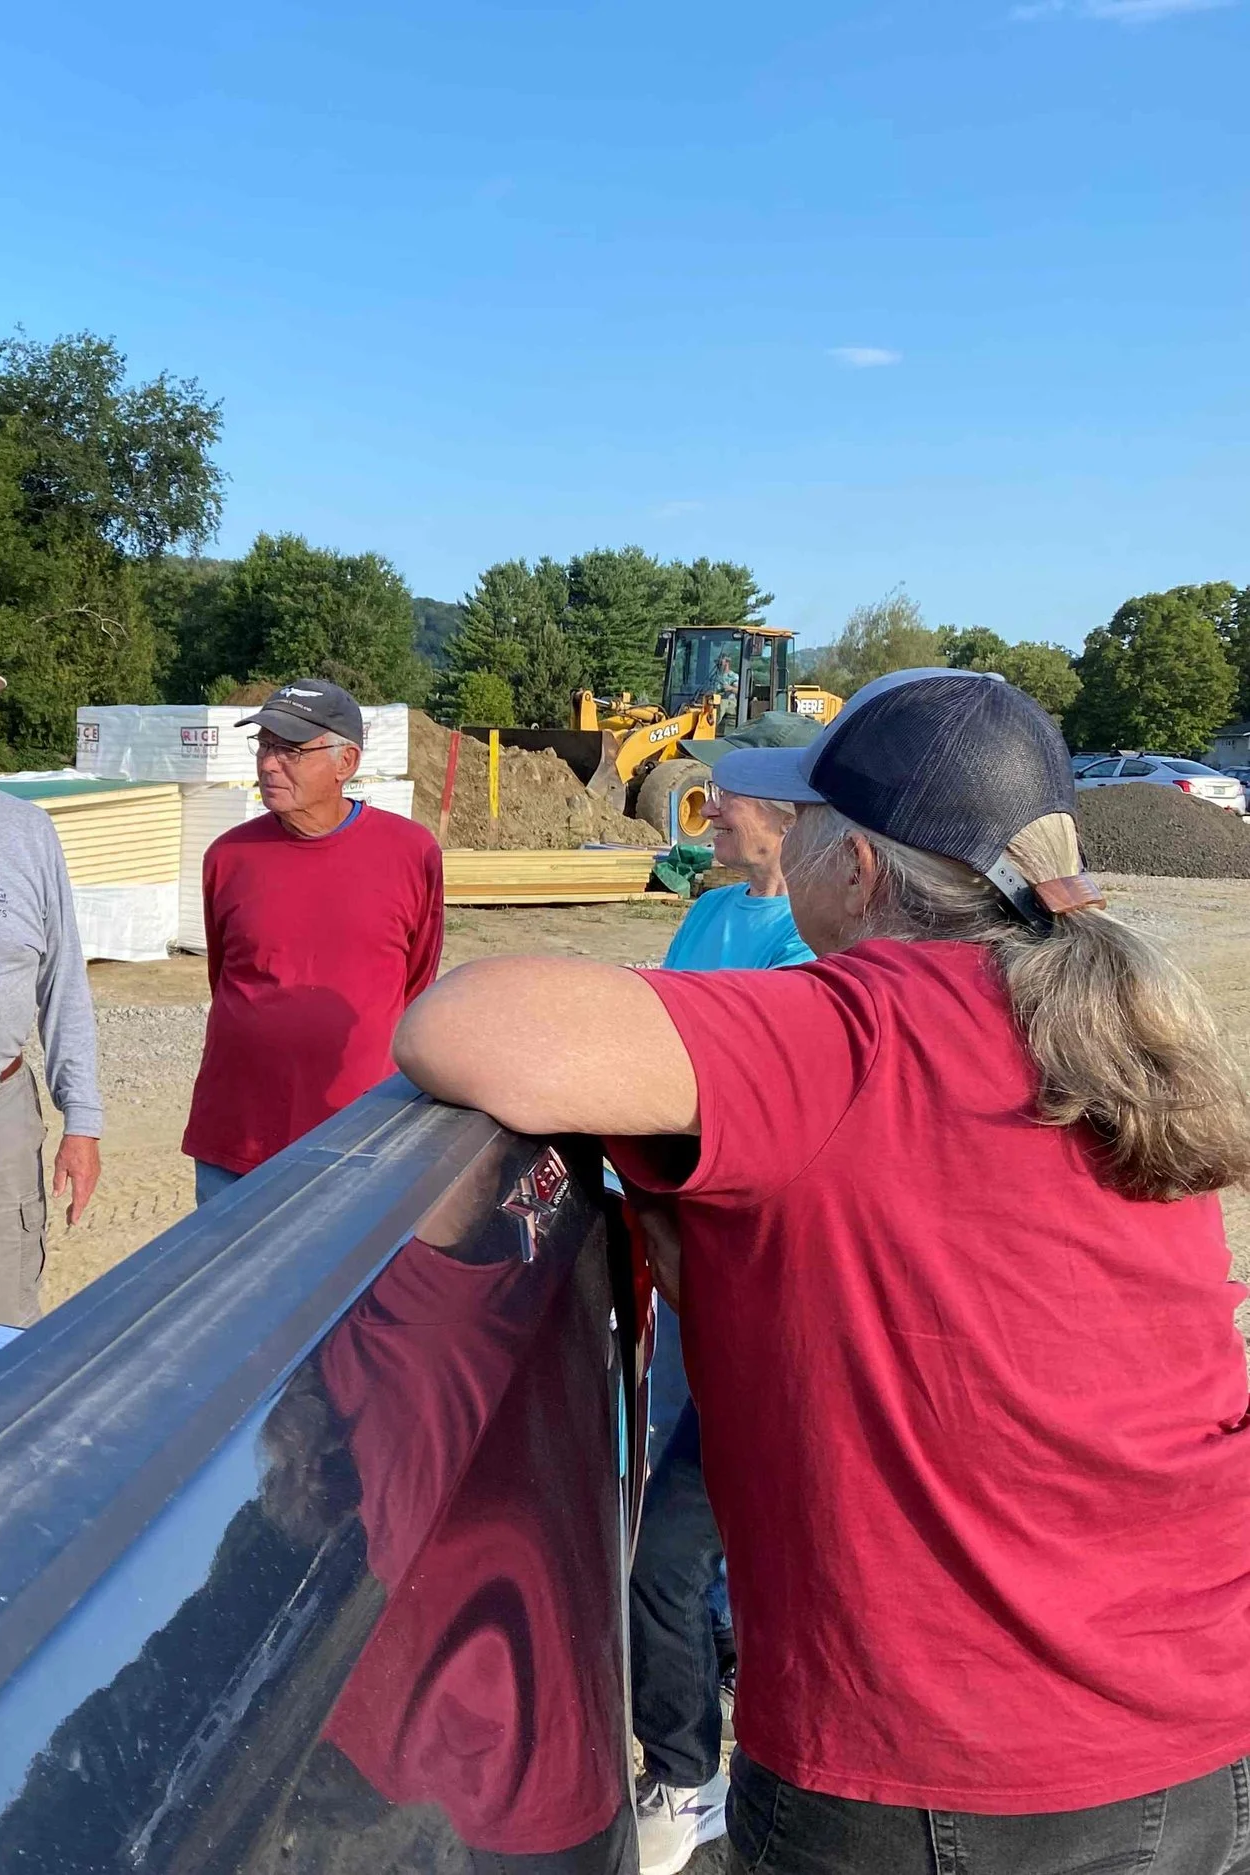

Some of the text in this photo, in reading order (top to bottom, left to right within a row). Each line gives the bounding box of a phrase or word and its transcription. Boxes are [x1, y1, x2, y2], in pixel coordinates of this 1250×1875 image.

[77, 728, 97, 738] ICE
[182, 730, 216, 741] RICE
[649, 723, 679, 743] 624H
